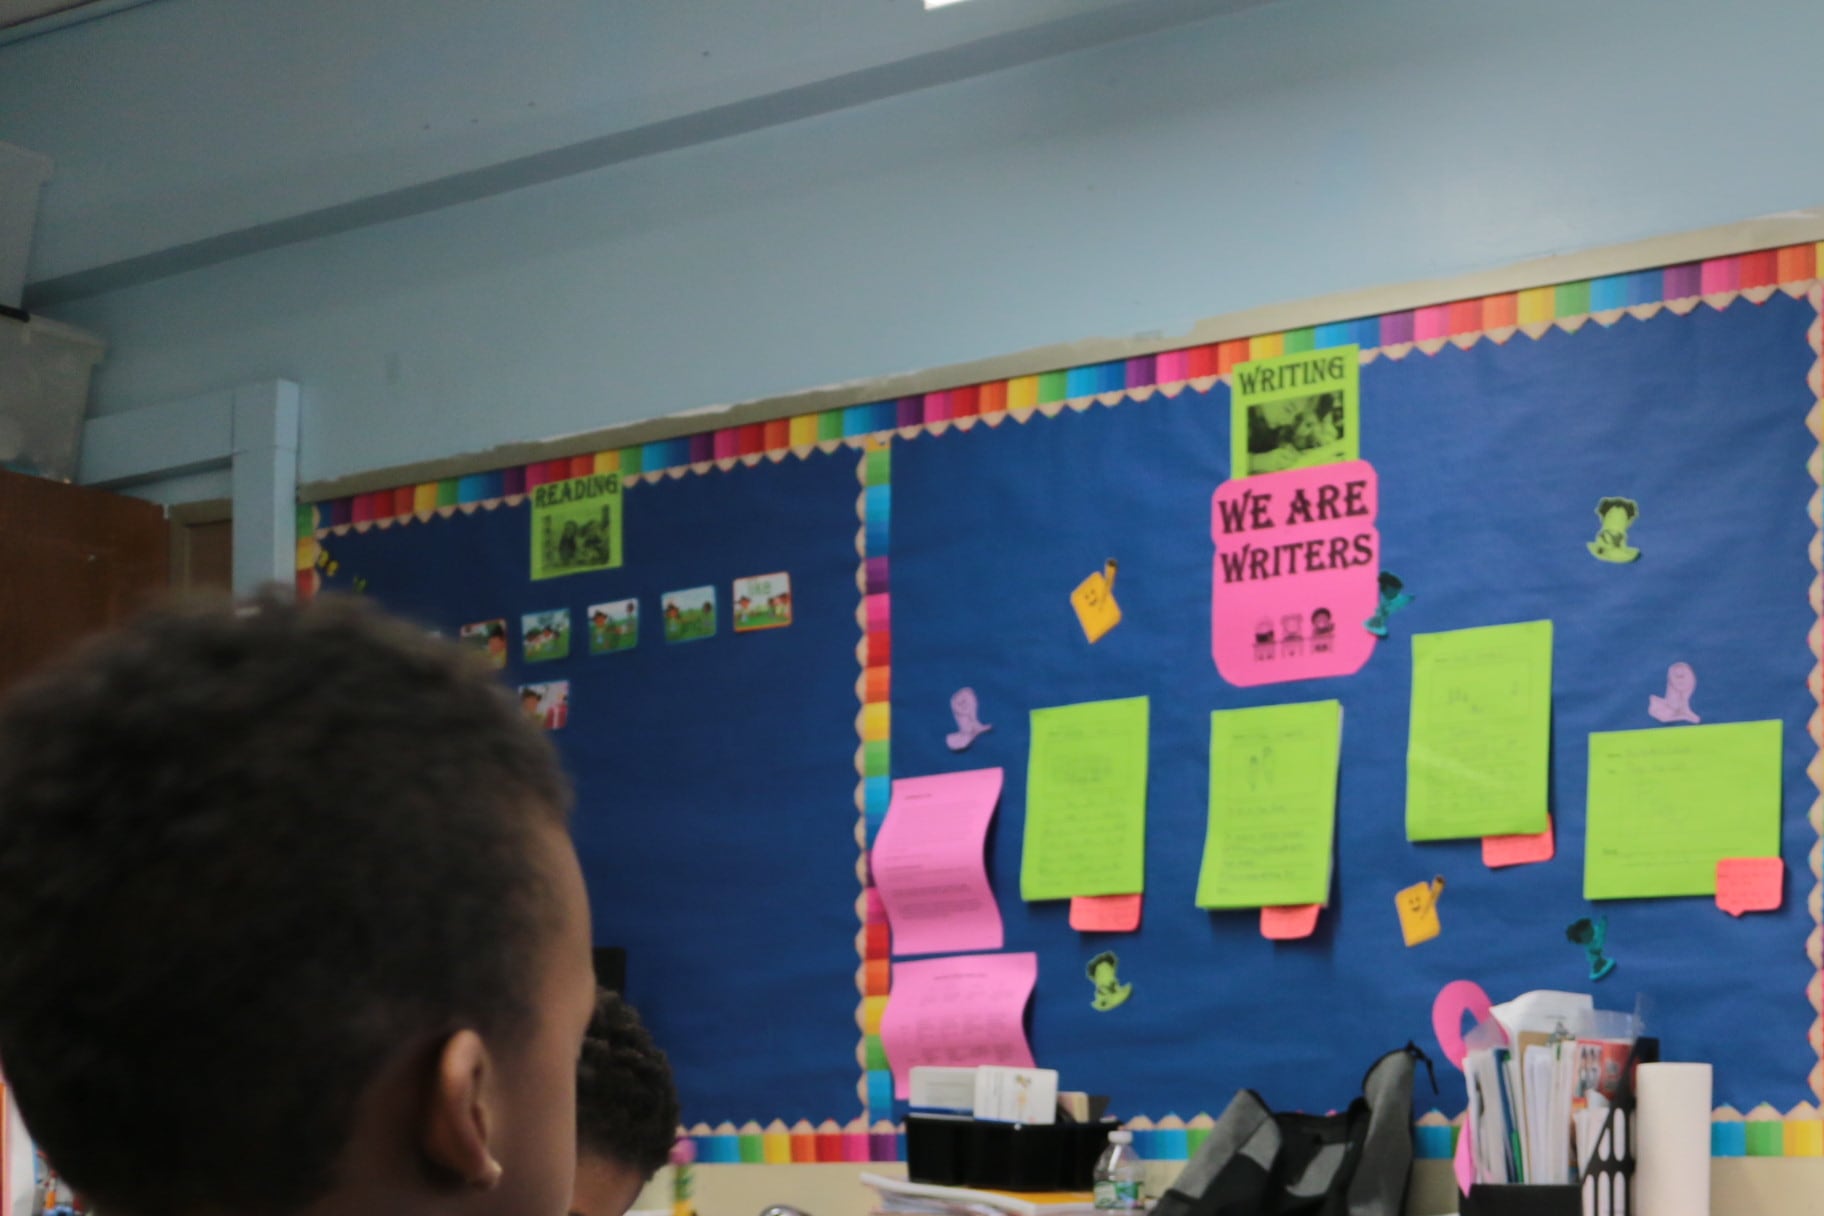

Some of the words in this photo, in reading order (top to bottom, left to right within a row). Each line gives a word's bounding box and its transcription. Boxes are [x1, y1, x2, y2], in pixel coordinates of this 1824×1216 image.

[1239, 356, 1346, 397] WRITING
[534, 474, 619, 508] READING
[1219, 488, 1274, 534] WE
[1286, 480, 1369, 524] ARE
[1220, 534, 1374, 584] WRITERS
